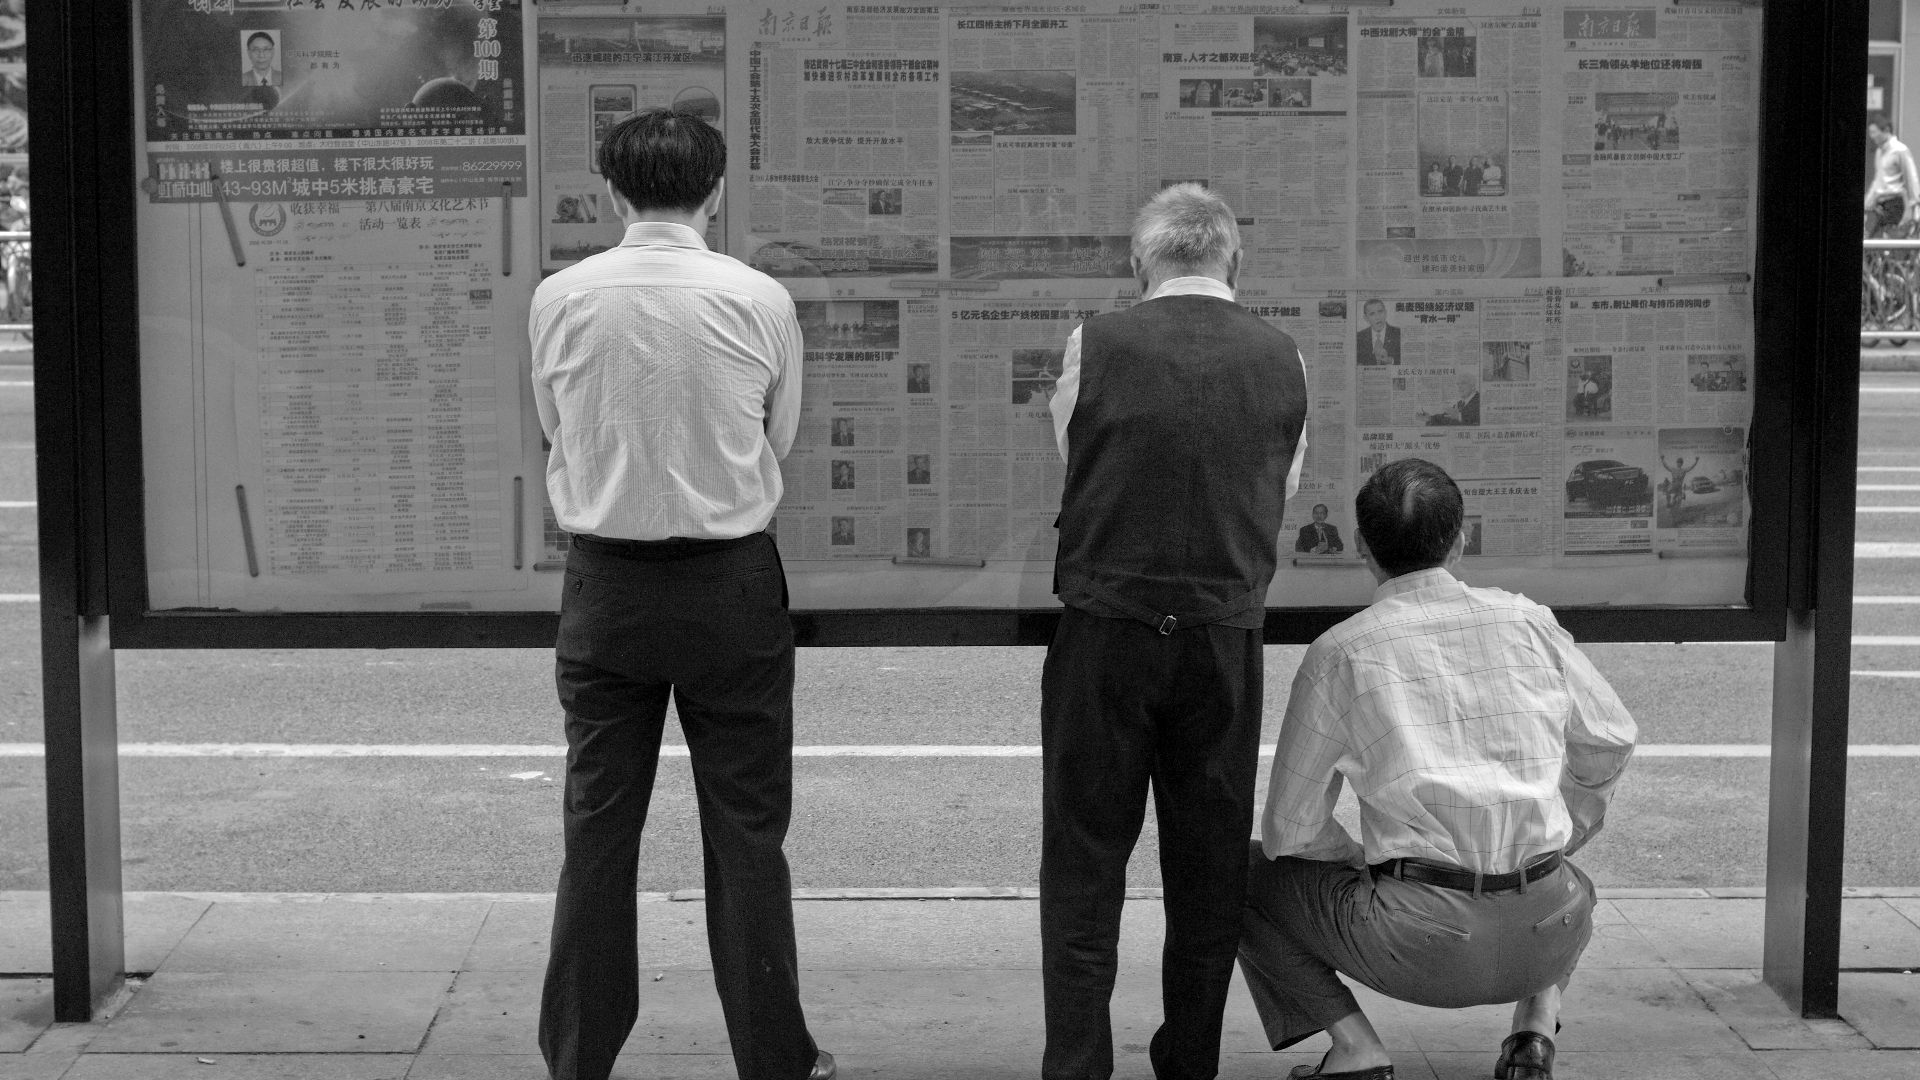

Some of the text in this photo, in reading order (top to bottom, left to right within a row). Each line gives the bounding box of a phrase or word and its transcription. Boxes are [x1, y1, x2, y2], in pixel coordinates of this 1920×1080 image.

[957, 20, 1070, 30] 长江四桥主桥下月全面开工
[1578, 58, 1703, 71] 长三角领头羊地位还将增强
[461, 161, 523, 172] 86229999
[359, 216, 421, 232] 活动一览表
[803, 351, 900, 363] 现科学发展的新引擎”
